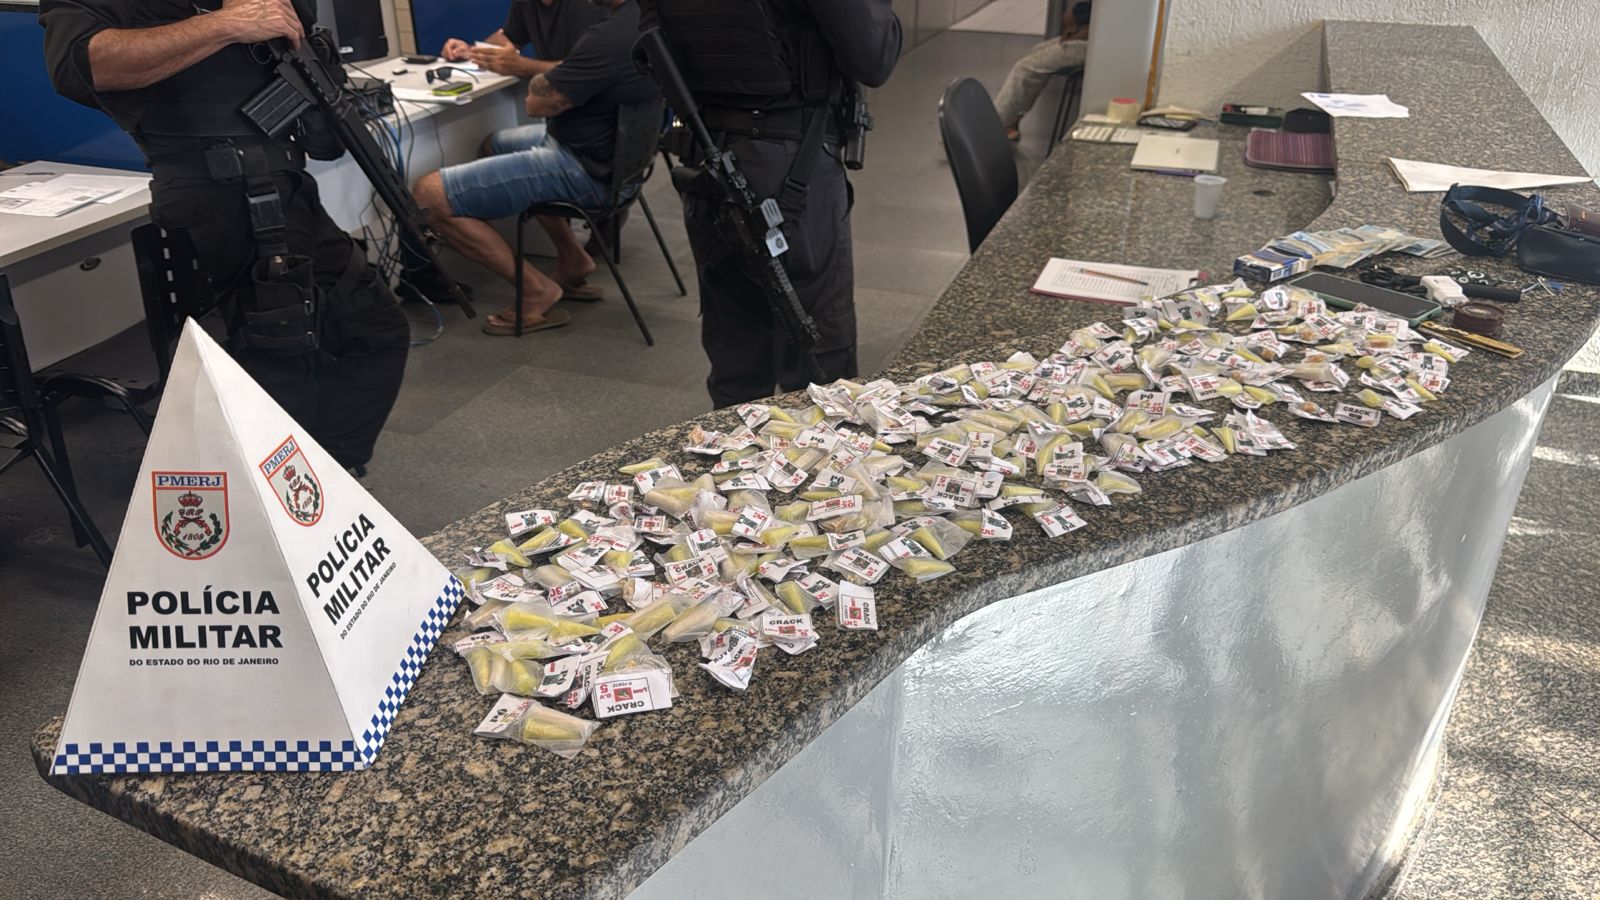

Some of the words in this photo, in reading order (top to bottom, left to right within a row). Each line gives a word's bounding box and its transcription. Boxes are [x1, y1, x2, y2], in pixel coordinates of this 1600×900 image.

[936, 440, 961, 452] CRACK
[263, 441, 295, 475] PMERJ
[157, 475, 222, 486] PMERJ
[937, 492, 965, 503] CRACK
[182, 533, 205, 541] 1809
[306, 513, 375, 599] POLÍCIA
[852, 549, 881, 565] CRACK
[323, 537, 391, 626] MILITAR
[127, 585, 280, 615] POLÍCIA
[340, 629, 348, 640] DO
[346, 608, 362, 632] ESTADO
[361, 600, 368, 611] DO
[366, 590, 375, 602] RIO
[373, 582, 381, 593] DE
[379, 562, 397, 585] JANEIRO
[129, 625, 283, 649] MILITAR
[146, 658, 184, 666] ESTADO
[187, 658, 200, 666] DO
[606, 700, 645, 714] CRACK
